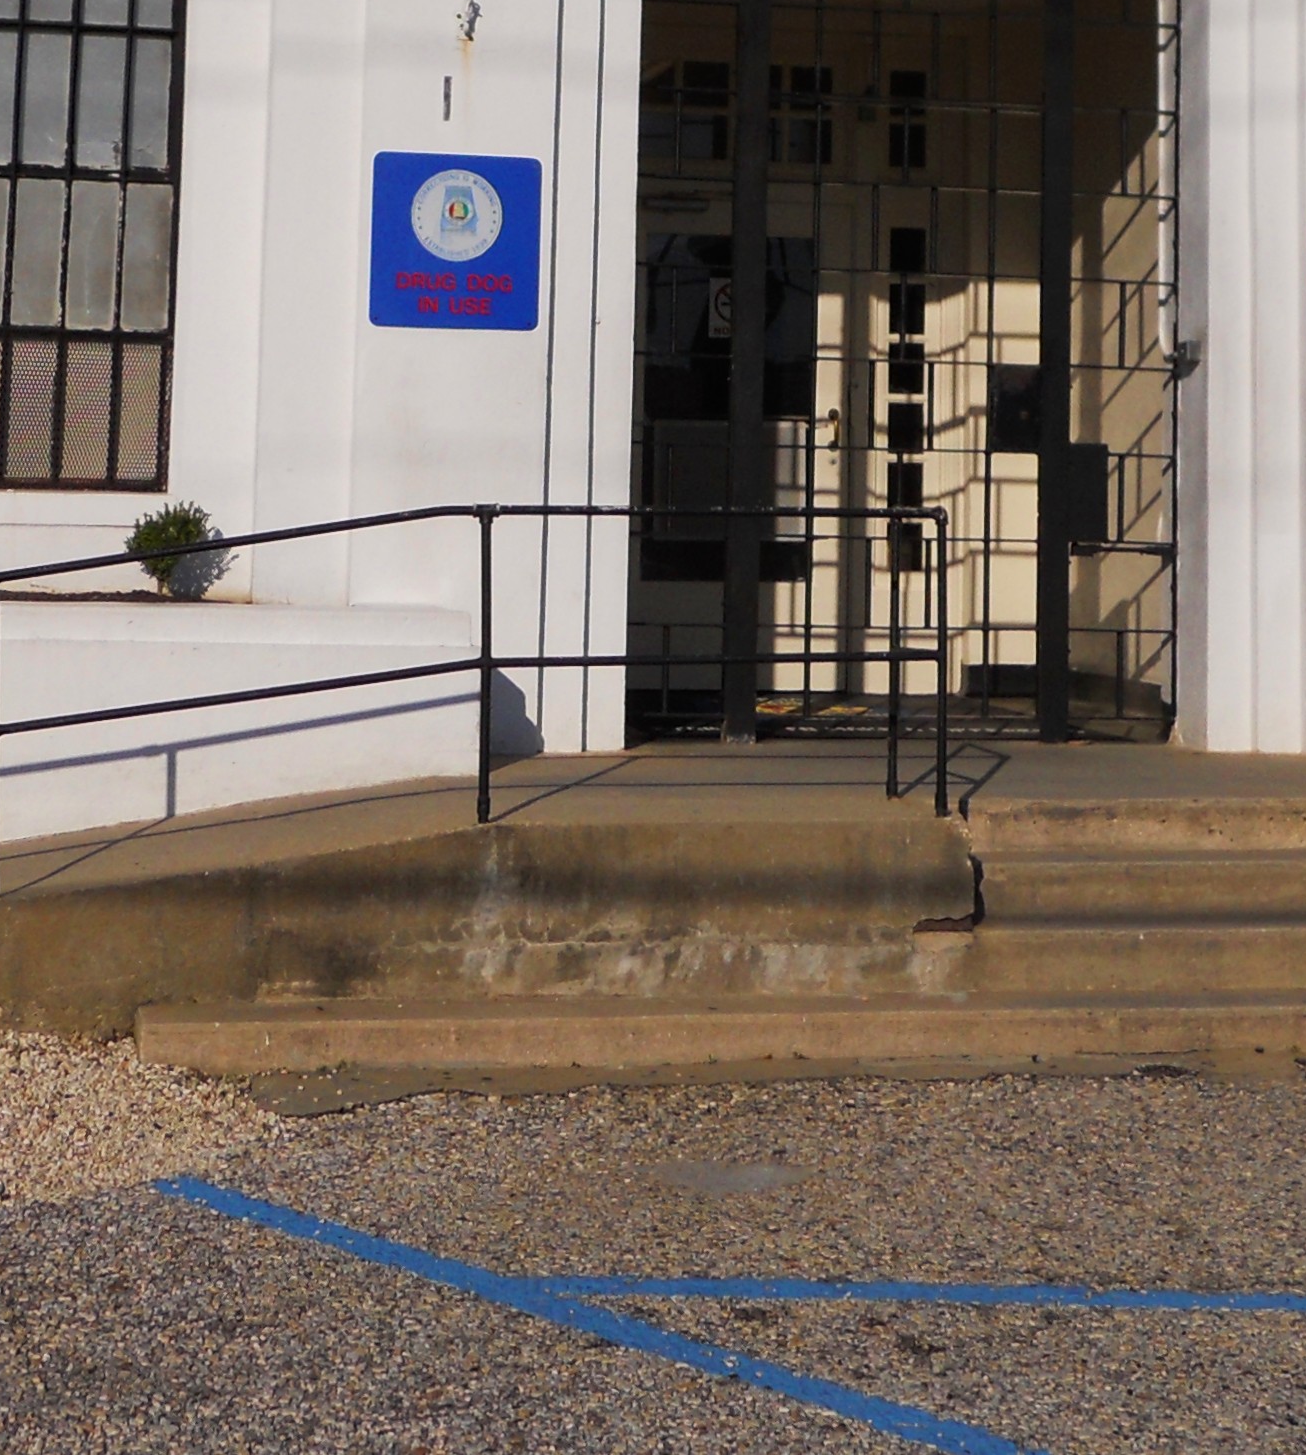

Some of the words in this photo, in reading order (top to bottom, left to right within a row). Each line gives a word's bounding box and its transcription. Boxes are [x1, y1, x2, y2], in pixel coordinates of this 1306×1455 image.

[396, 271, 457, 290] DRUG
[467, 274, 513, 293] DOG
[418, 296, 439, 313] IN
[449, 297, 491, 315] USE
